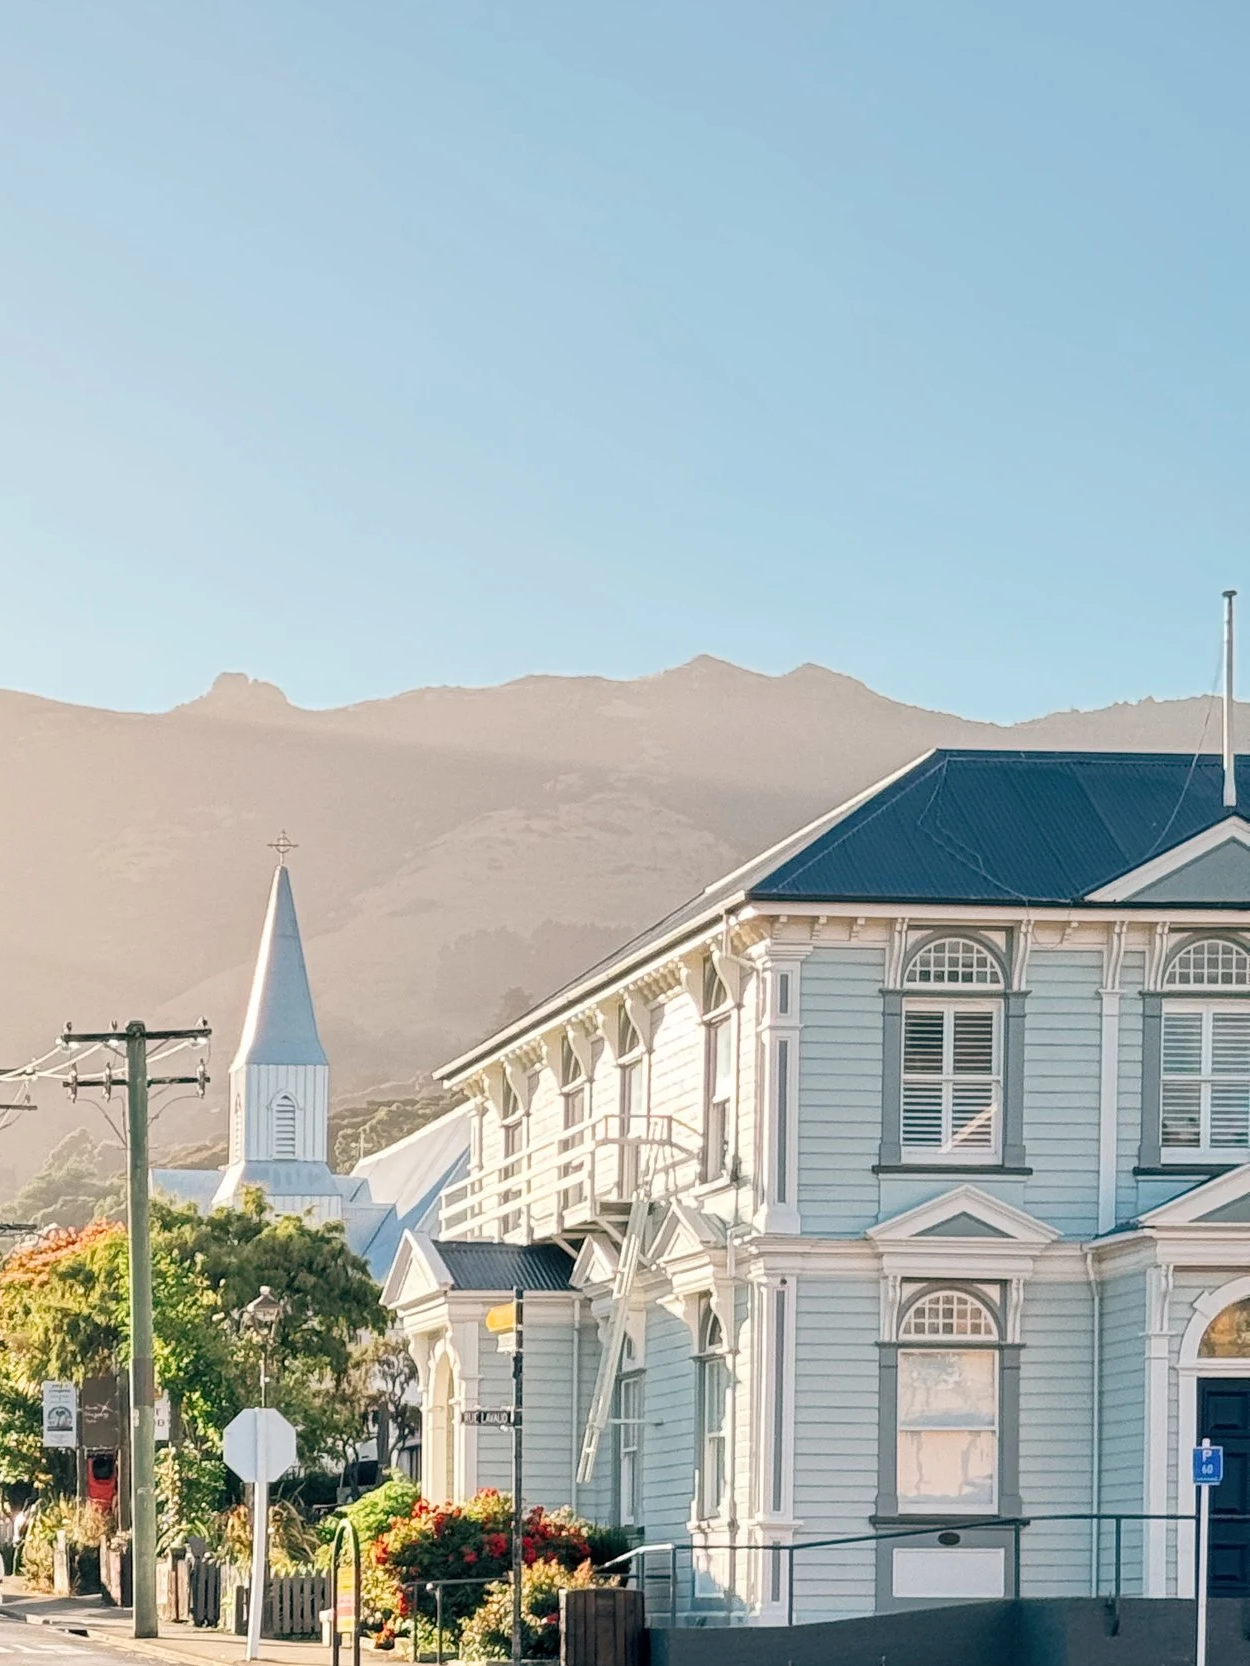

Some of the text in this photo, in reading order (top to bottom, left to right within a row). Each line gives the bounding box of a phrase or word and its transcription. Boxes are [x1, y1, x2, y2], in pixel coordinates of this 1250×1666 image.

[464, 1412, 508, 1424] RUE LAVAUD
[1202, 1449, 1212, 1462] P
[1201, 1464, 1213, 1474] 60
